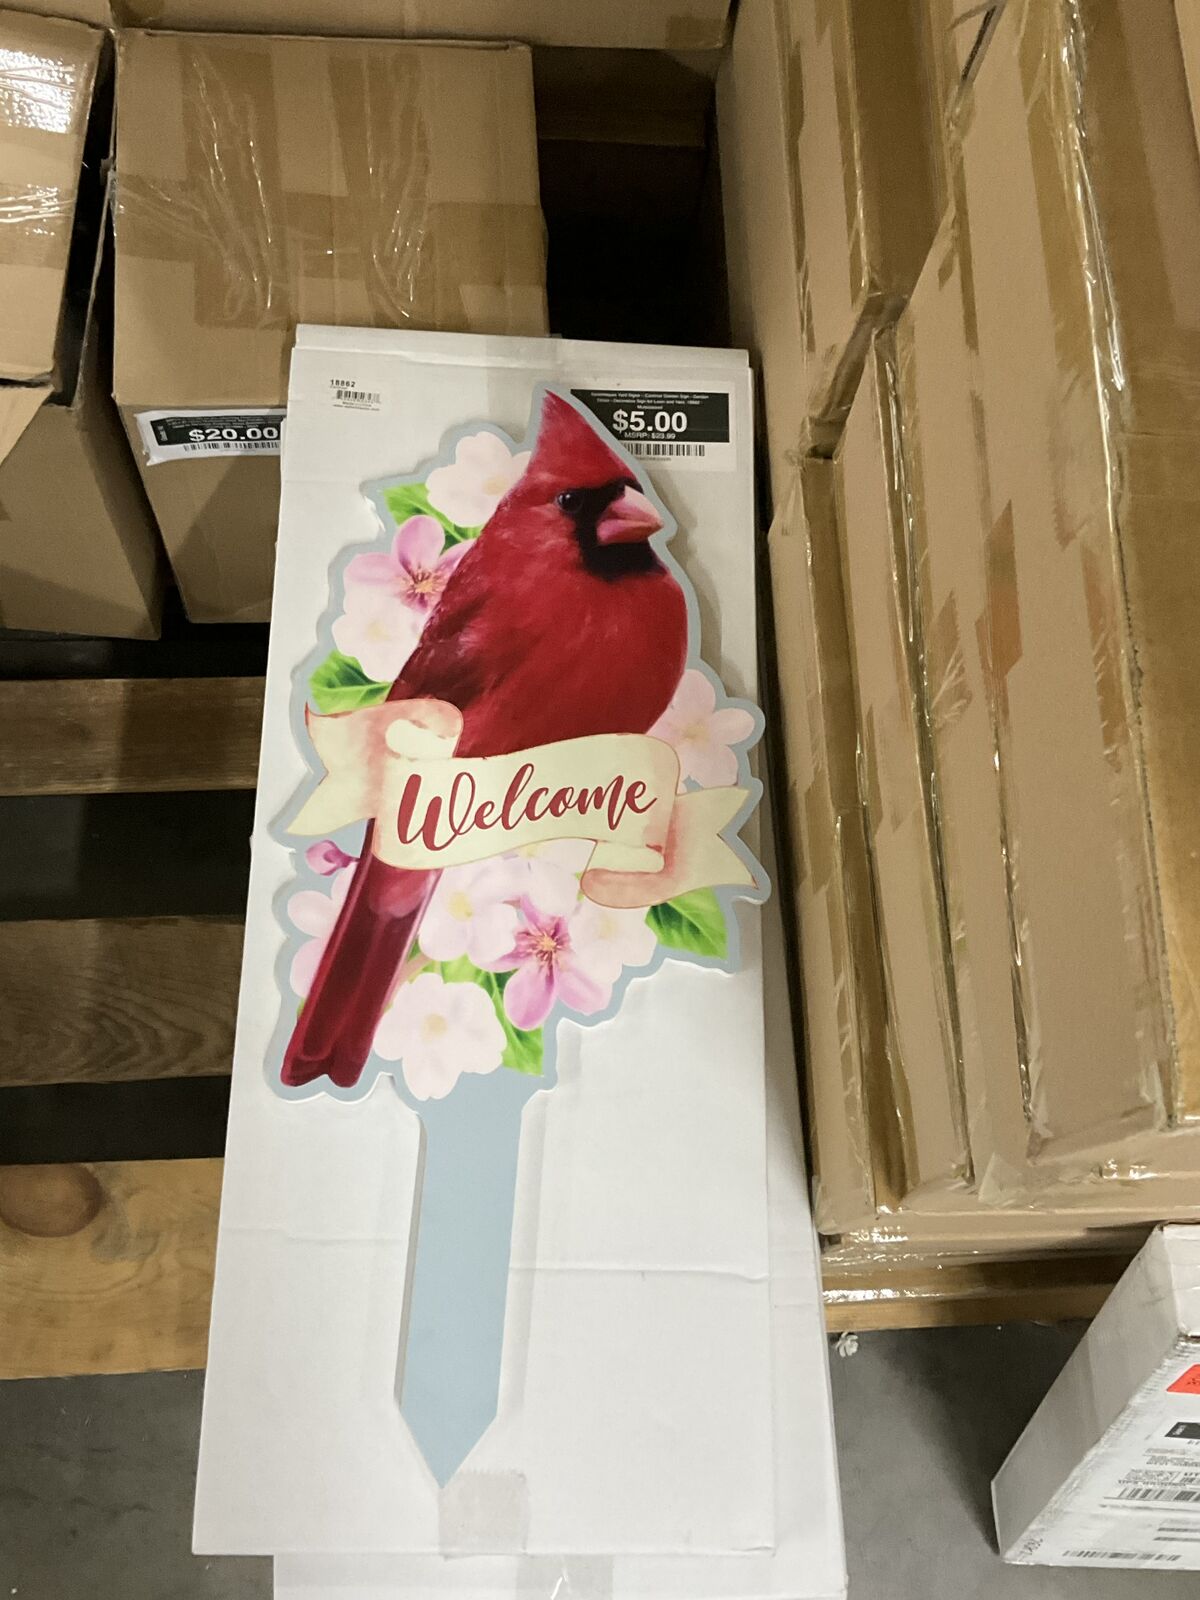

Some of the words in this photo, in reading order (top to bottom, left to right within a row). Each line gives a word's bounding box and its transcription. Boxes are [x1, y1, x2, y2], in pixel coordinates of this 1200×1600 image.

[612, 409, 687, 433] $5.00
[188, 427, 279, 442] $20.00
[624, 431, 650, 439] MSRP:
[397, 763, 658, 852] Welcome
